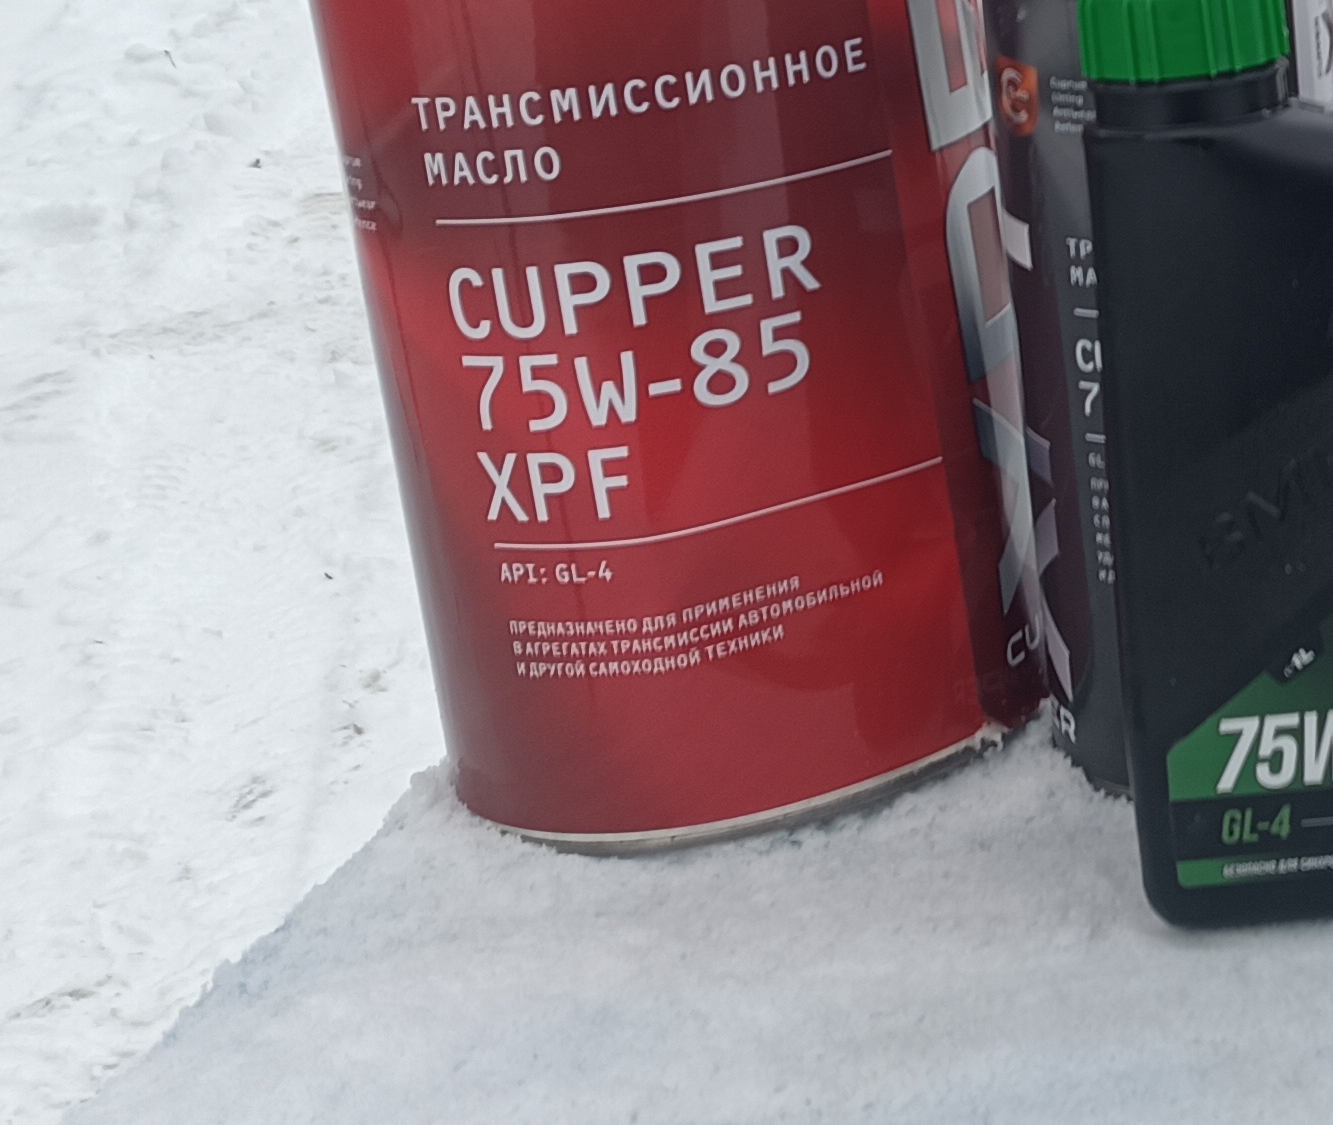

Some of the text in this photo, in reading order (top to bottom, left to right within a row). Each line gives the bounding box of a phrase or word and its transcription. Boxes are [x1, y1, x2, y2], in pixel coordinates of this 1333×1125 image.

[411, 37, 868, 133] ТРАНСМИССИОННОЕ
[425, 145, 562, 187] МАСЛО
[447, 224, 821, 342] CUPPER
[461, 311, 810, 432] 75W-85
[476, 446, 630, 523] XPF
[500, 560, 613, 585] API: GL-4
[509, 576, 801, 638] ПРЕДНАЗНАЧЕНО ДЛЯ ПРИМЕНЕНИЯ
[513, 569, 884, 658] В АГРЕГАТАХ ТРАНСМИССИИ АВТОМОБИЛЬНОЙ
[516, 624, 785, 678] И ДРУГОЙ САМОХОДНОЙ ТЕХНИКИ
[1222, 804, 1293, 845] GL-4
